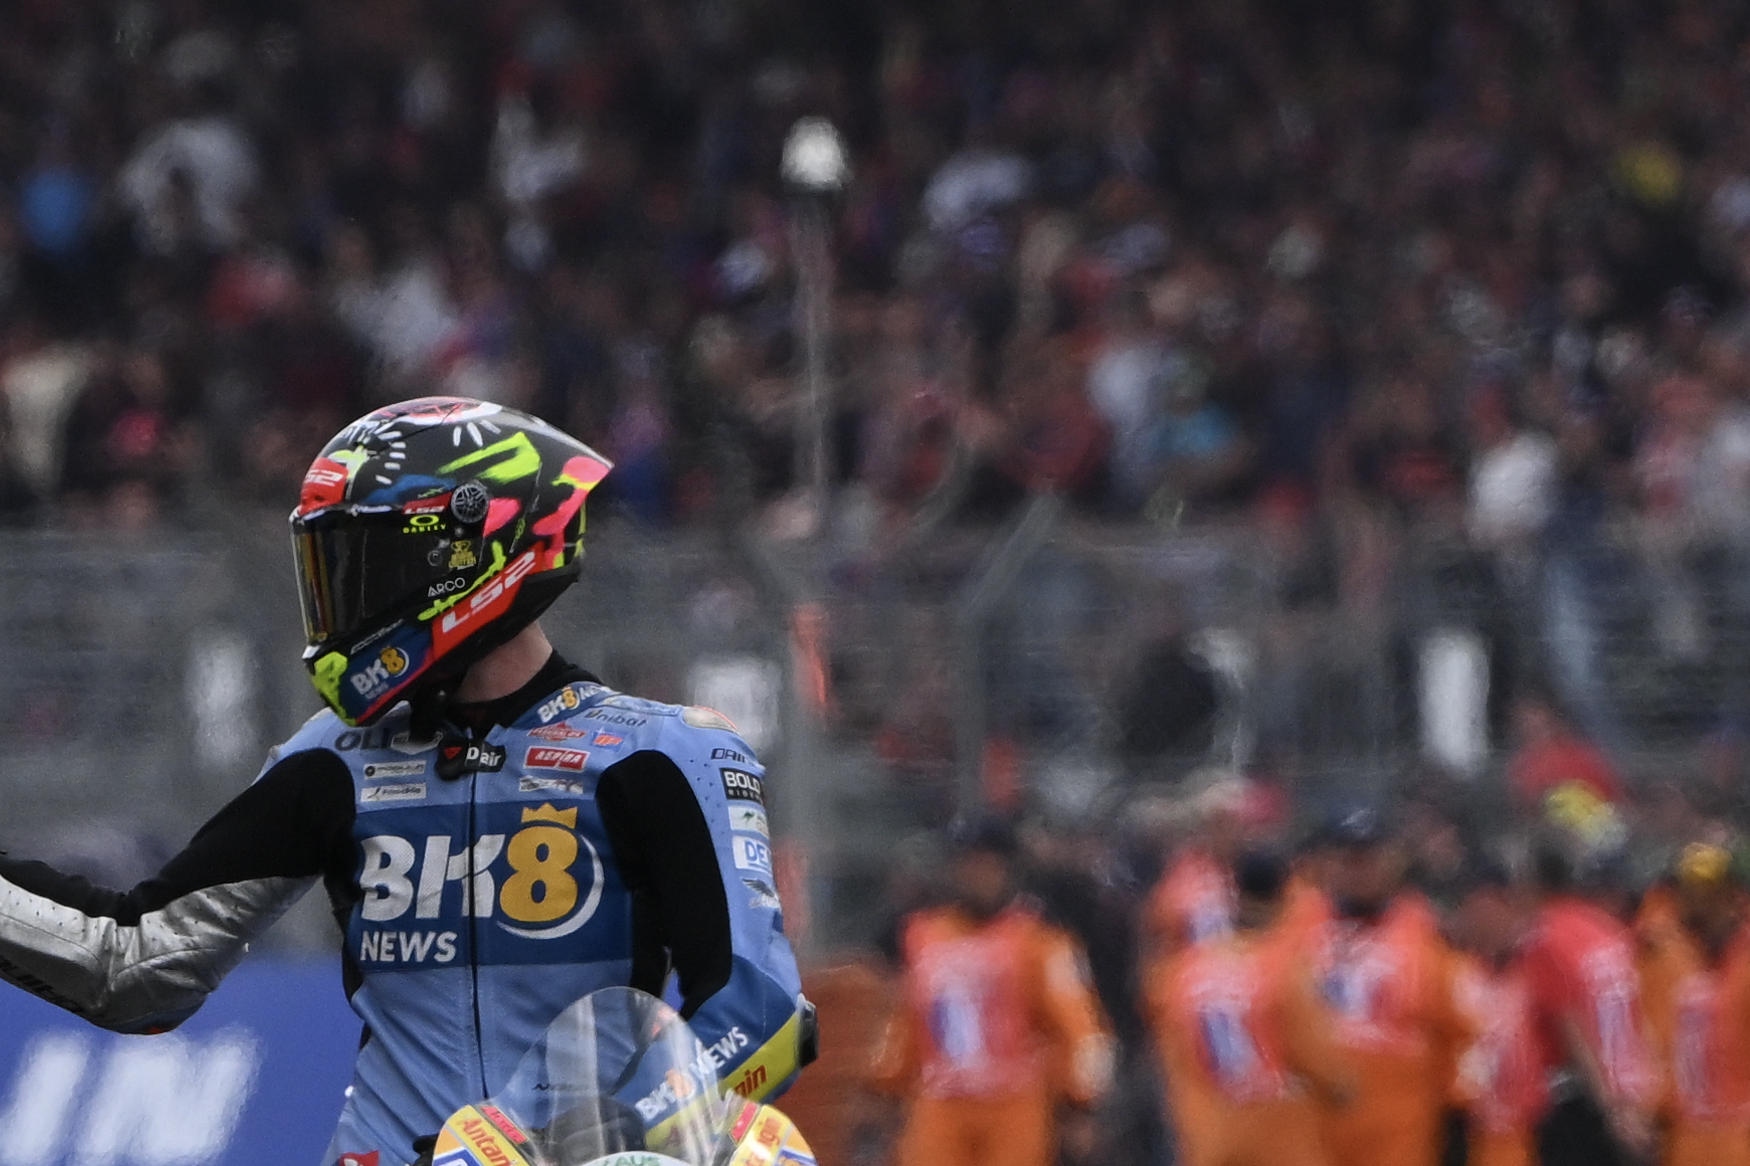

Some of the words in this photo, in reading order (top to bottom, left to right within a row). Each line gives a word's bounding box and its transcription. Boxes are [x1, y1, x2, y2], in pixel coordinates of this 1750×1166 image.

[305, 468, 345, 487] S2
[427, 577, 466, 598] ARCO
[442, 551, 536, 633] LS2
[350, 646, 405, 695] BK8
[537, 686, 580, 724] BK8
[585, 708, 647, 729] Unibat
[535, 749, 585, 764] ASPIRA
[724, 770, 761, 792] BOLD
[359, 824, 579, 922] BK8
[360, 930, 458, 963] NEWS
